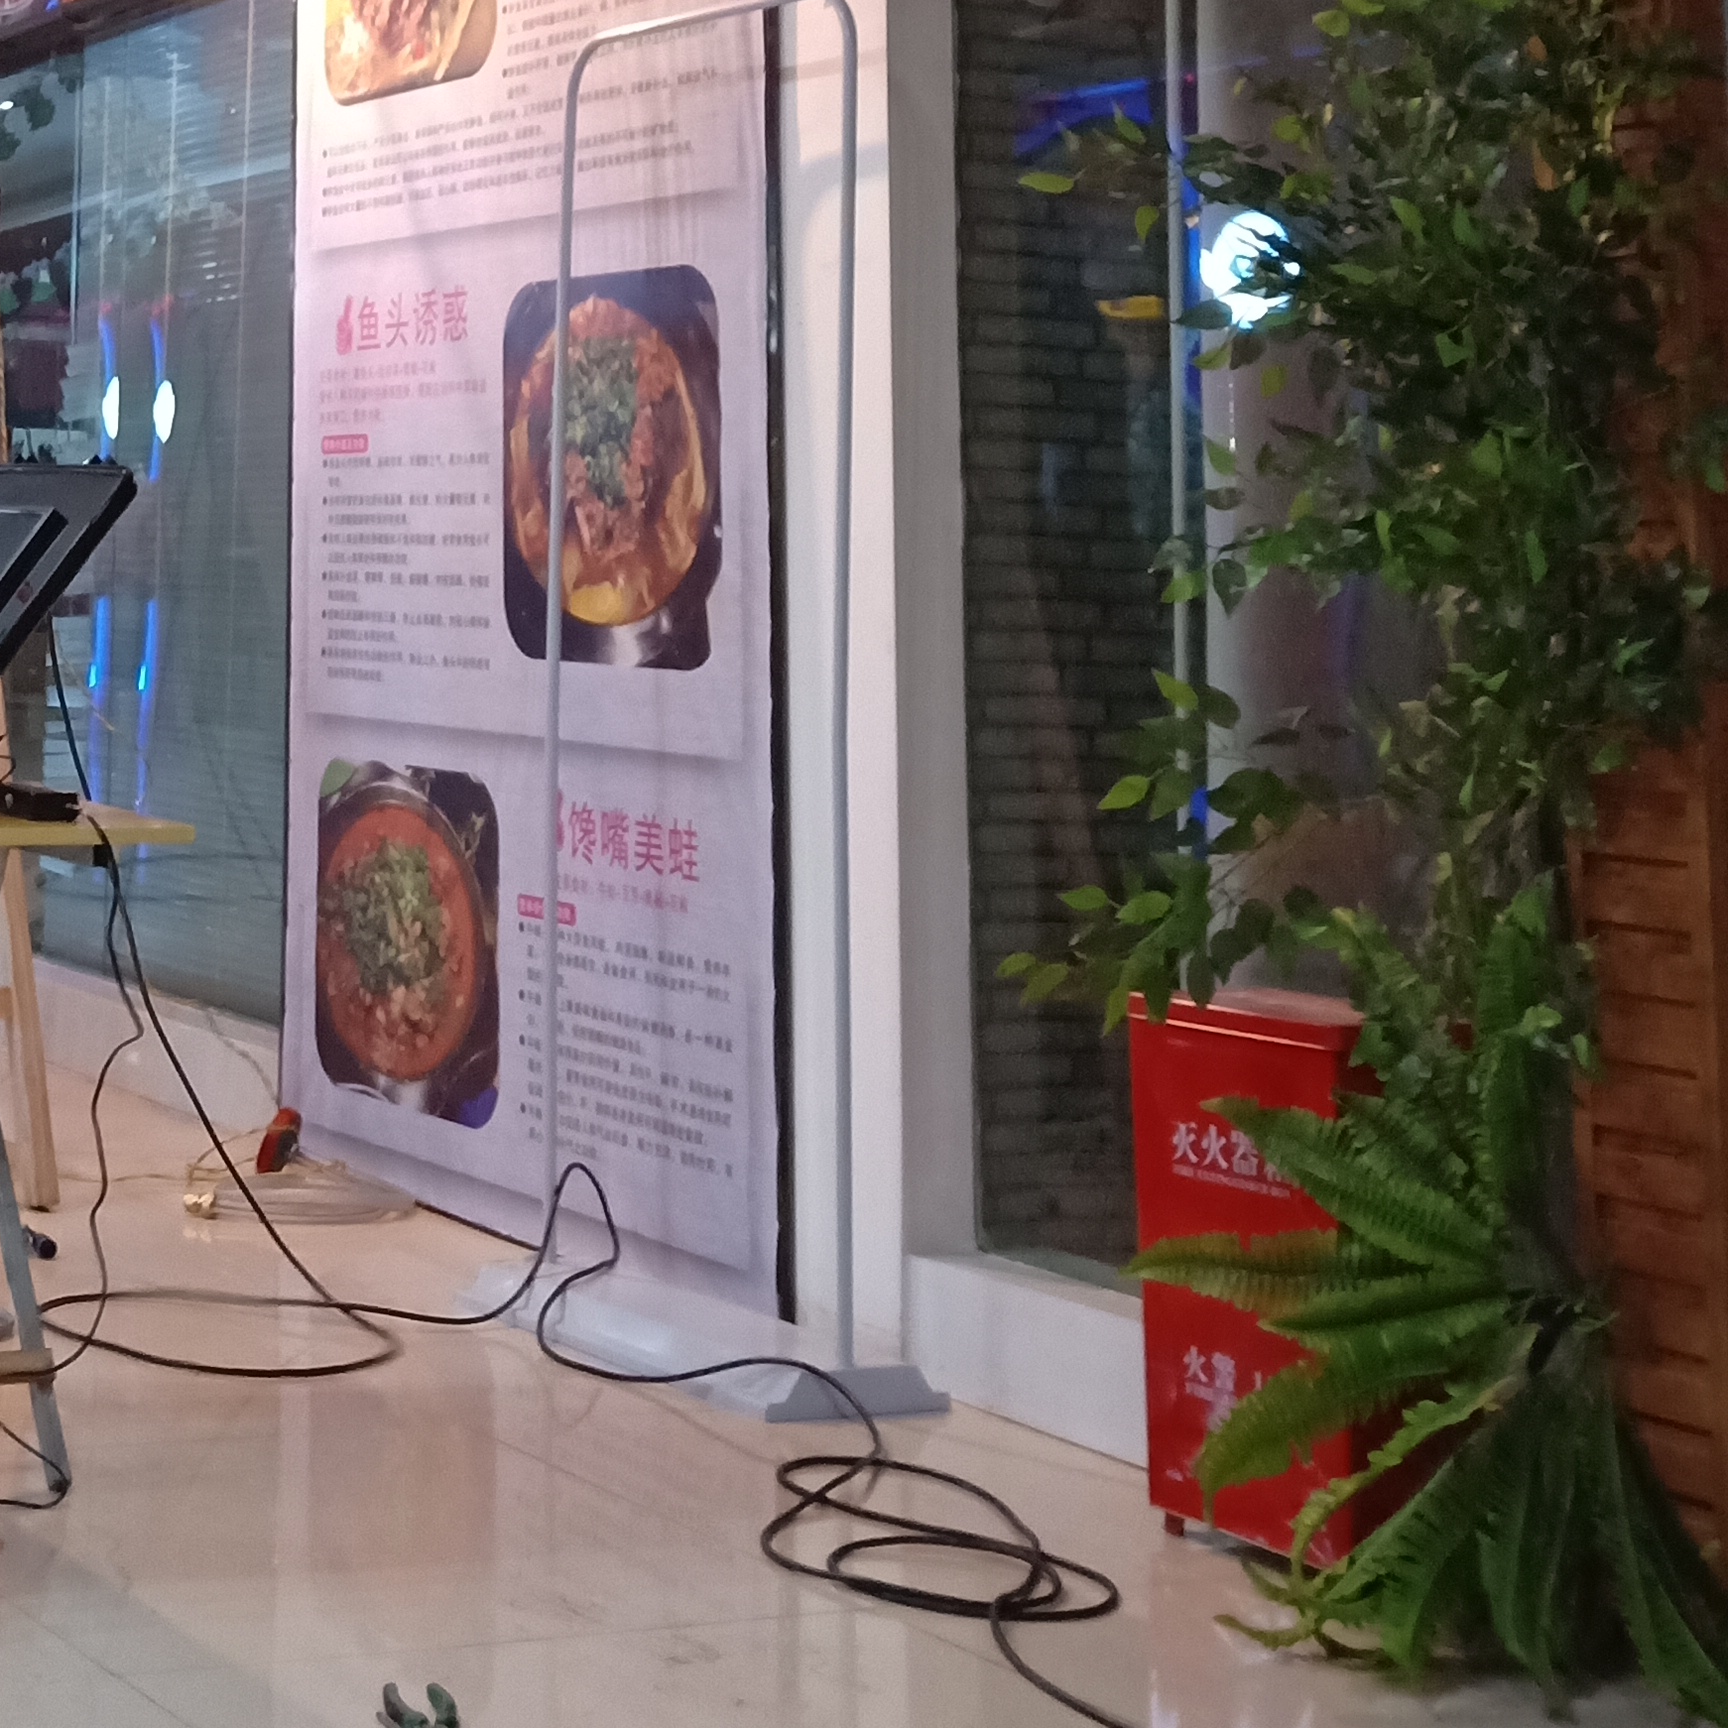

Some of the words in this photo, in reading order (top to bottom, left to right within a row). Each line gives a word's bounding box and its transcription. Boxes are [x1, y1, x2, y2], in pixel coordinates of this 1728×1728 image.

[356, 284, 469, 351] 鱼头诱惑
[568, 801, 701, 882] 馋嘴美蛙
[1171, 1120, 1300, 1189] 灭火器
